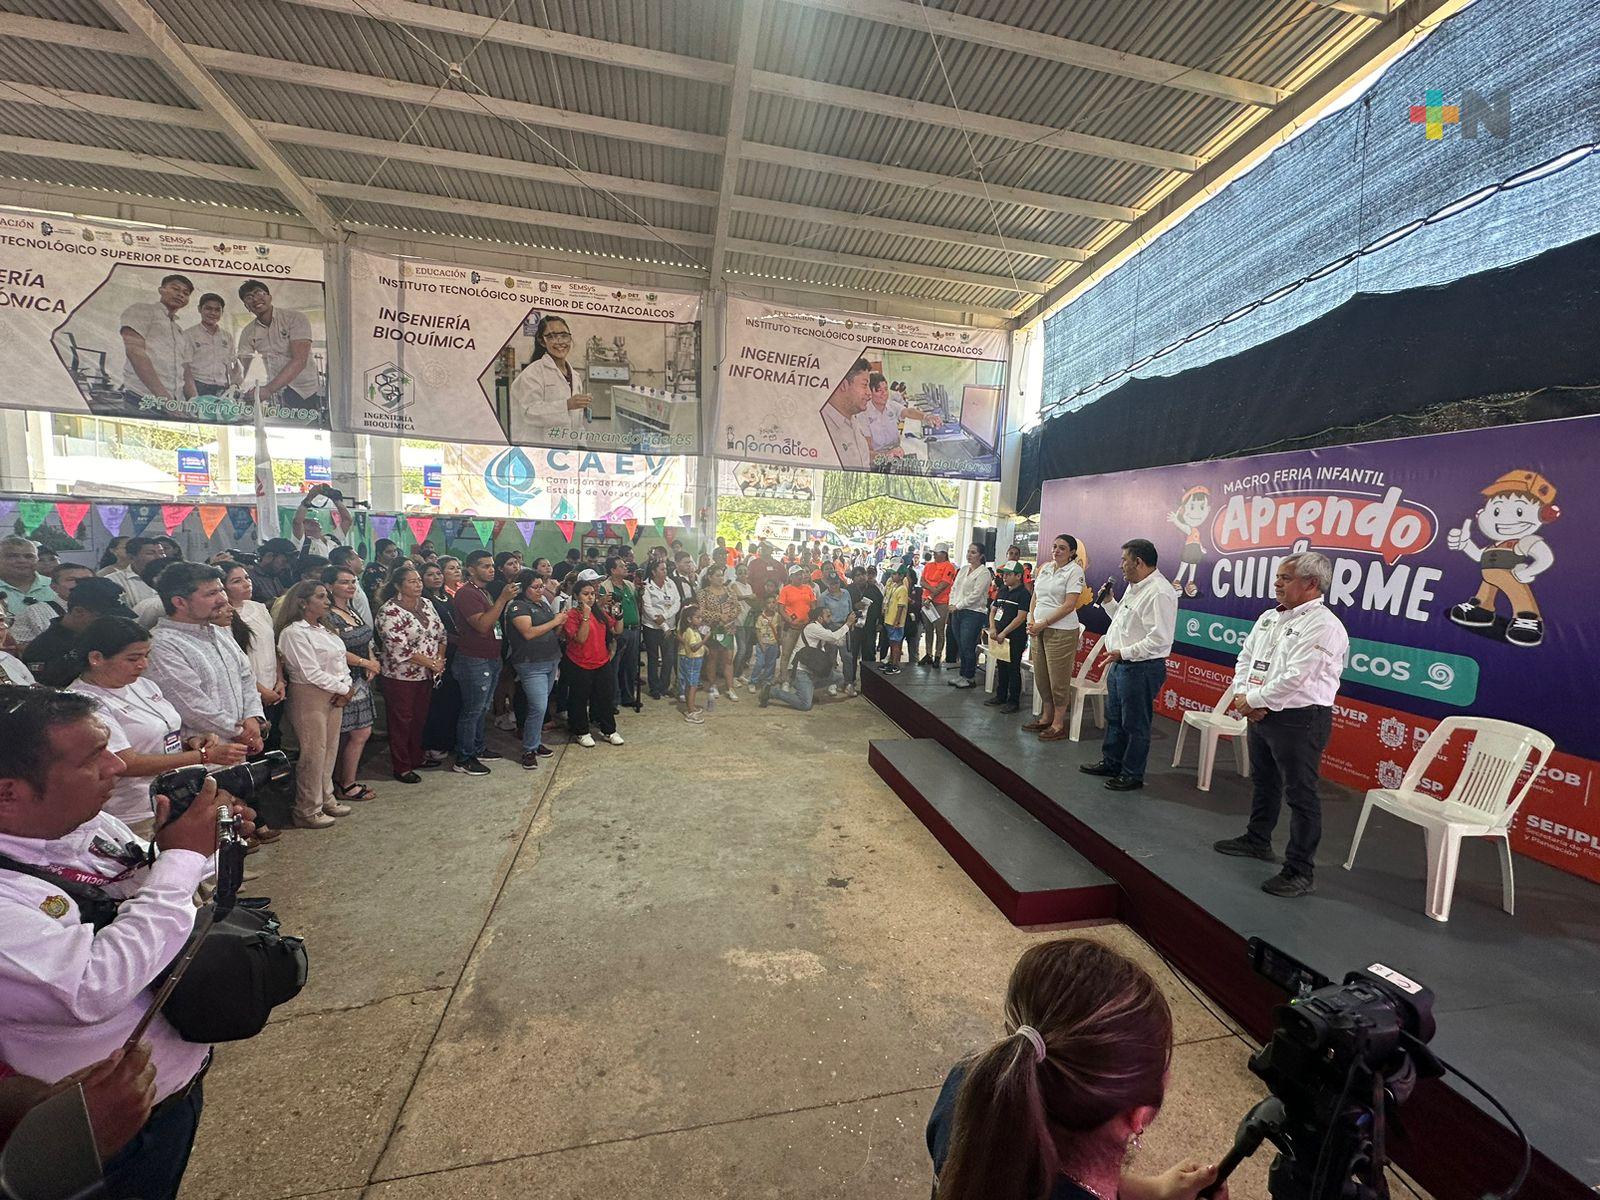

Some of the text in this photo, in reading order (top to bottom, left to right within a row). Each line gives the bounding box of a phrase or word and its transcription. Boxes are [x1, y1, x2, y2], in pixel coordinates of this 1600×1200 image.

[1, 235, 97, 256] TECNOLÓGICO
[101, 249, 161, 263] SUPERIOR
[164, 254, 179, 264] DE
[183, 256, 291, 275] COATZACOALCOS
[415, 267, 466, 278] EDUCACIÓN
[378, 276, 437, 293] INSTITUTO
[440, 284, 517, 302] TECNOLÓGICO
[519, 294, 569, 308] SUPERIOR
[572, 301, 584, 310] DE
[586, 302, 675, 318] COATZACOALCOS
[379, 307, 471, 331] INGENIERÍA
[373, 326, 476, 350] BIOQUÍMICA
[745, 318, 791, 333] INSTITUTO
[793, 326, 855, 342] TECNOLÓGICO
[856, 335, 896, 347] SUPERIOR
[898, 339, 909, 348] DE
[911, 341, 983, 356] COATZACOALCOS
[740, 346, 820, 369] INGENIERÍA
[728, 364, 830, 389] INFORMÁTICA
[546, 448, 668, 476] CAEV
[1223, 467, 1385, 494] MACRO FERIA INFANTIL
[1164, 659, 1180, 669] SEV
